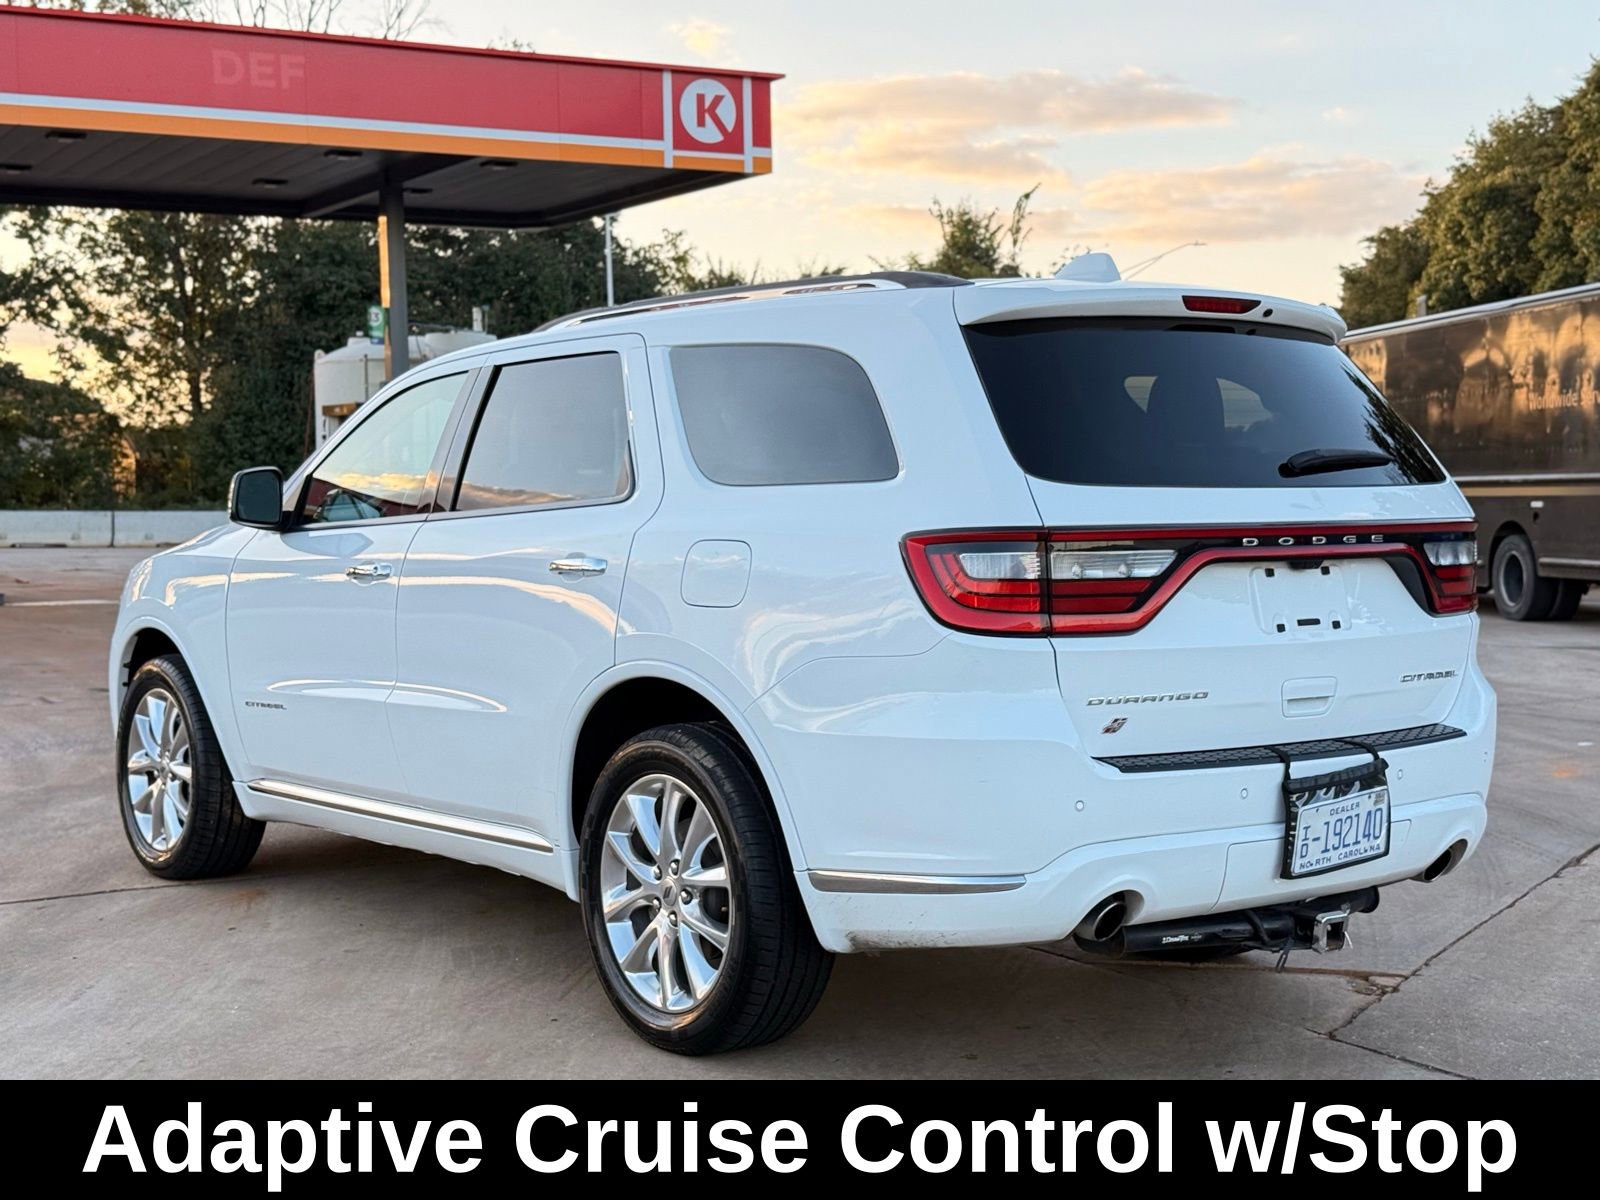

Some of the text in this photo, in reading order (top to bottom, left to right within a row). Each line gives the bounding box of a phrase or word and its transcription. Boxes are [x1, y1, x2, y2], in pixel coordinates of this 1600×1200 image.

[212, 49, 305, 89] DEF
[696, 92, 729, 139] K
[1242, 534, 1384, 546] DODGE
[1400, 670, 1458, 683] CITADEL
[1086, 691, 1209, 706] DURANGO
[1329, 801, 1361, 816] DEALER
[1299, 843, 1381, 870] NORTH CAROLINA
